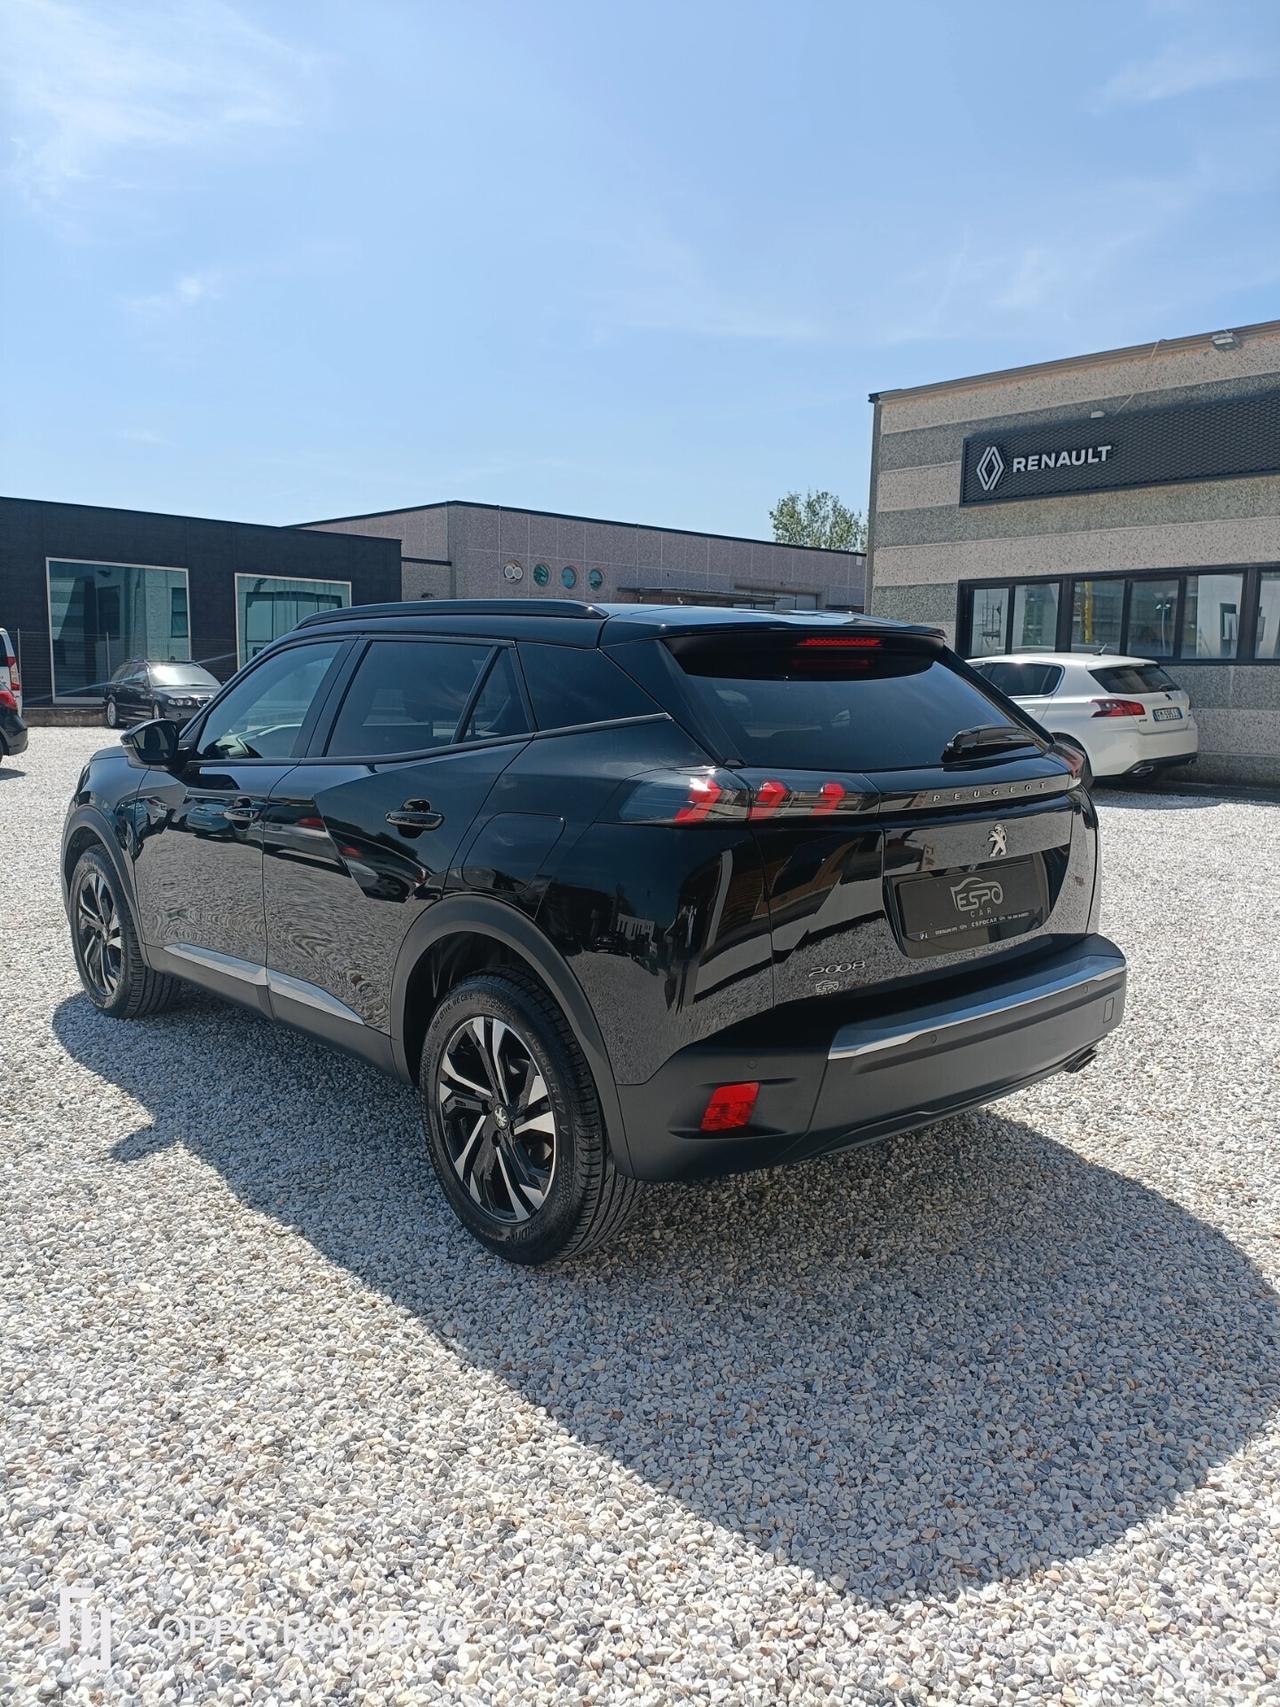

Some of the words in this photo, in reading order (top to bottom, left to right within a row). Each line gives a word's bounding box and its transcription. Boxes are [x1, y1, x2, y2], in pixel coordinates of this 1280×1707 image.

[1012, 445, 1112, 473] RENAULT
[932, 782, 1047, 802] PEUGEOT
[954, 881, 1004, 911] ESPO
[970, 908, 992, 918] CAR
[971, 917, 998, 928] ESPOCAR
[808, 960, 866, 978] 2008
